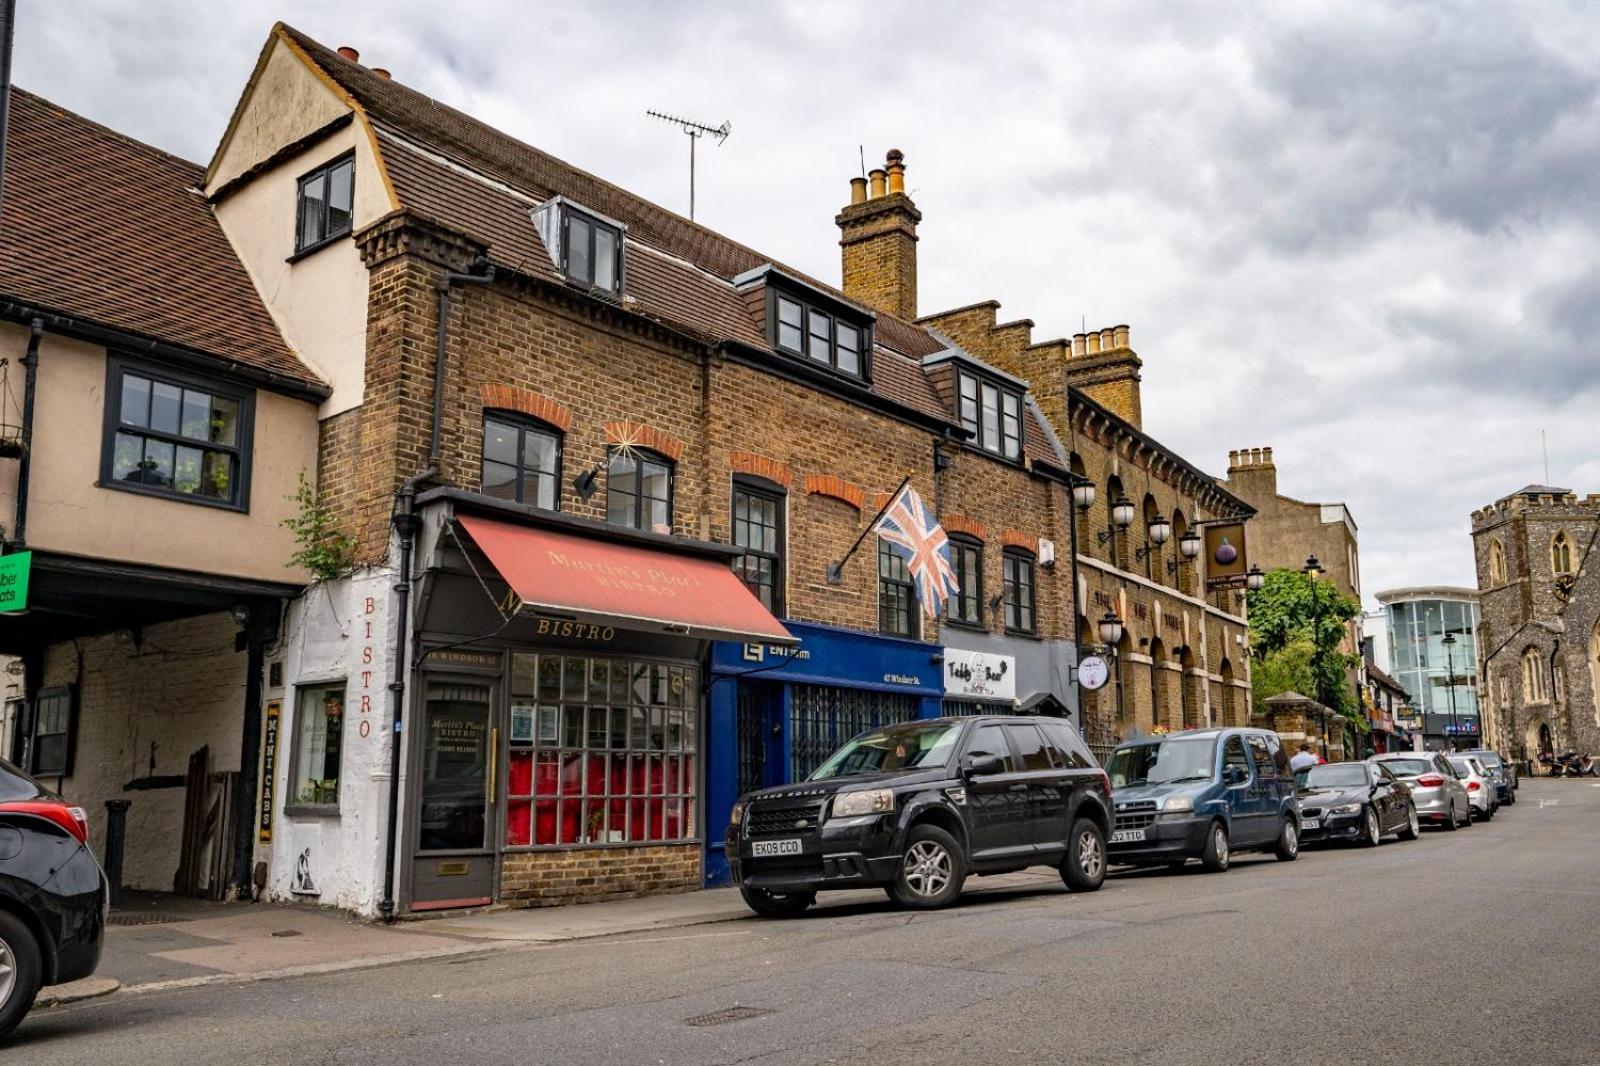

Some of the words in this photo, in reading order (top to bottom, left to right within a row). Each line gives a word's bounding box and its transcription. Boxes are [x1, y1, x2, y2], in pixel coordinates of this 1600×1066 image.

[0, 573, 16, 587] ber
[0, 589, 16, 603] ats
[537, 619, 615, 641] BISTRO
[358, 597, 374, 738] BISTRO
[266, 720, 277, 769] MINI
[262, 775, 272, 825] CABS
[787, 789, 826, 797] ROVER
[755, 843, 778, 855] EK09
